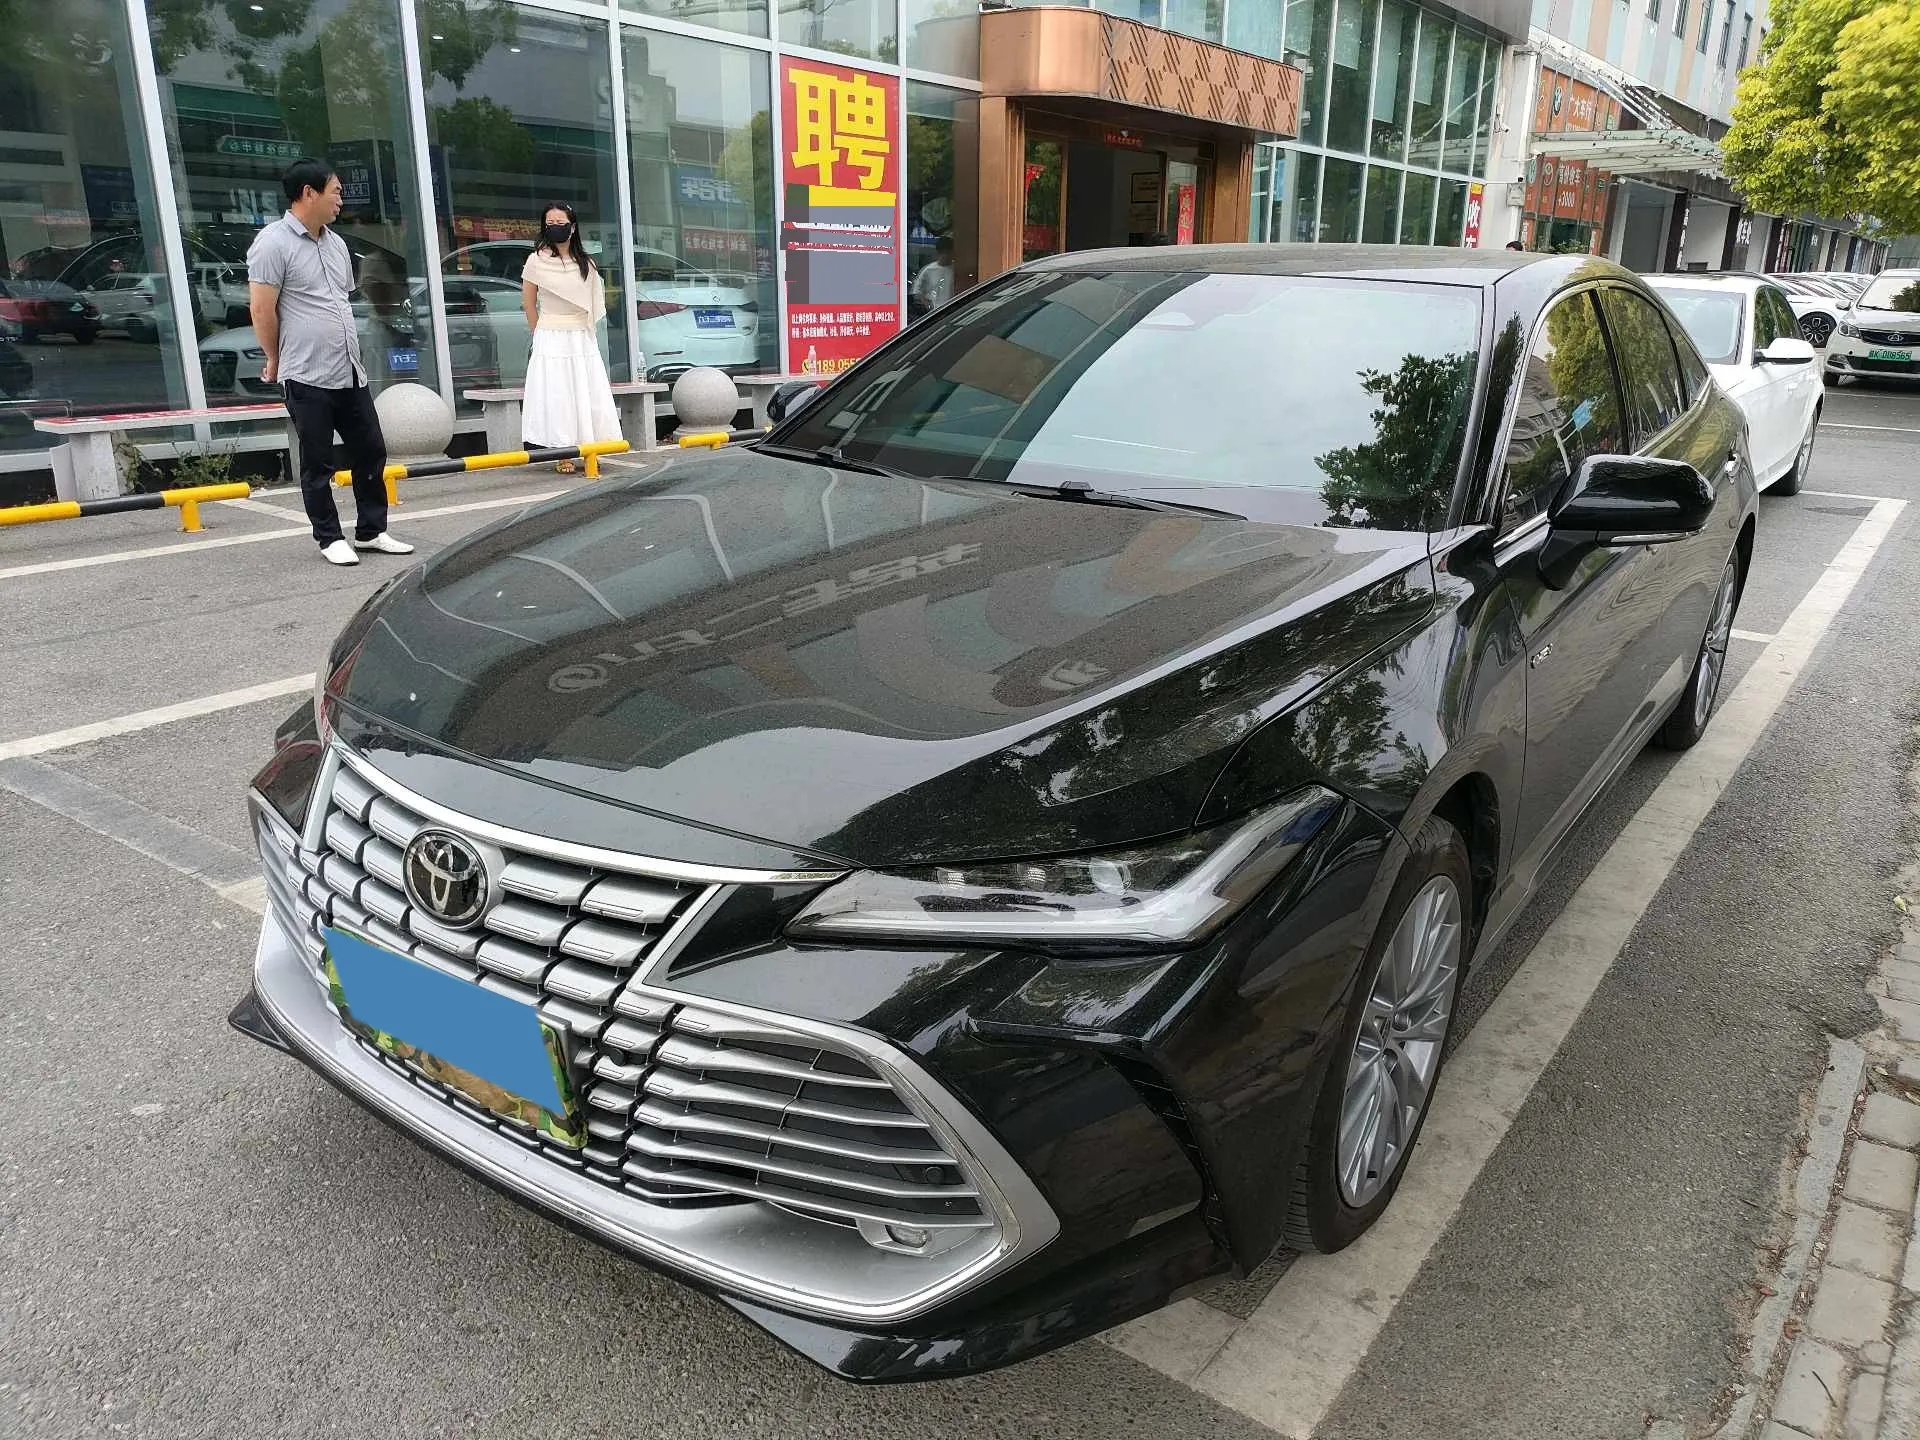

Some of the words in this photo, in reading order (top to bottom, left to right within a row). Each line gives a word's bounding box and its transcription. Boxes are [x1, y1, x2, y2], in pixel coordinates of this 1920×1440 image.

[788, 67, 890, 190] 聘
[817, 359, 835, 373] 189
[838, 357, 862, 371] 055
